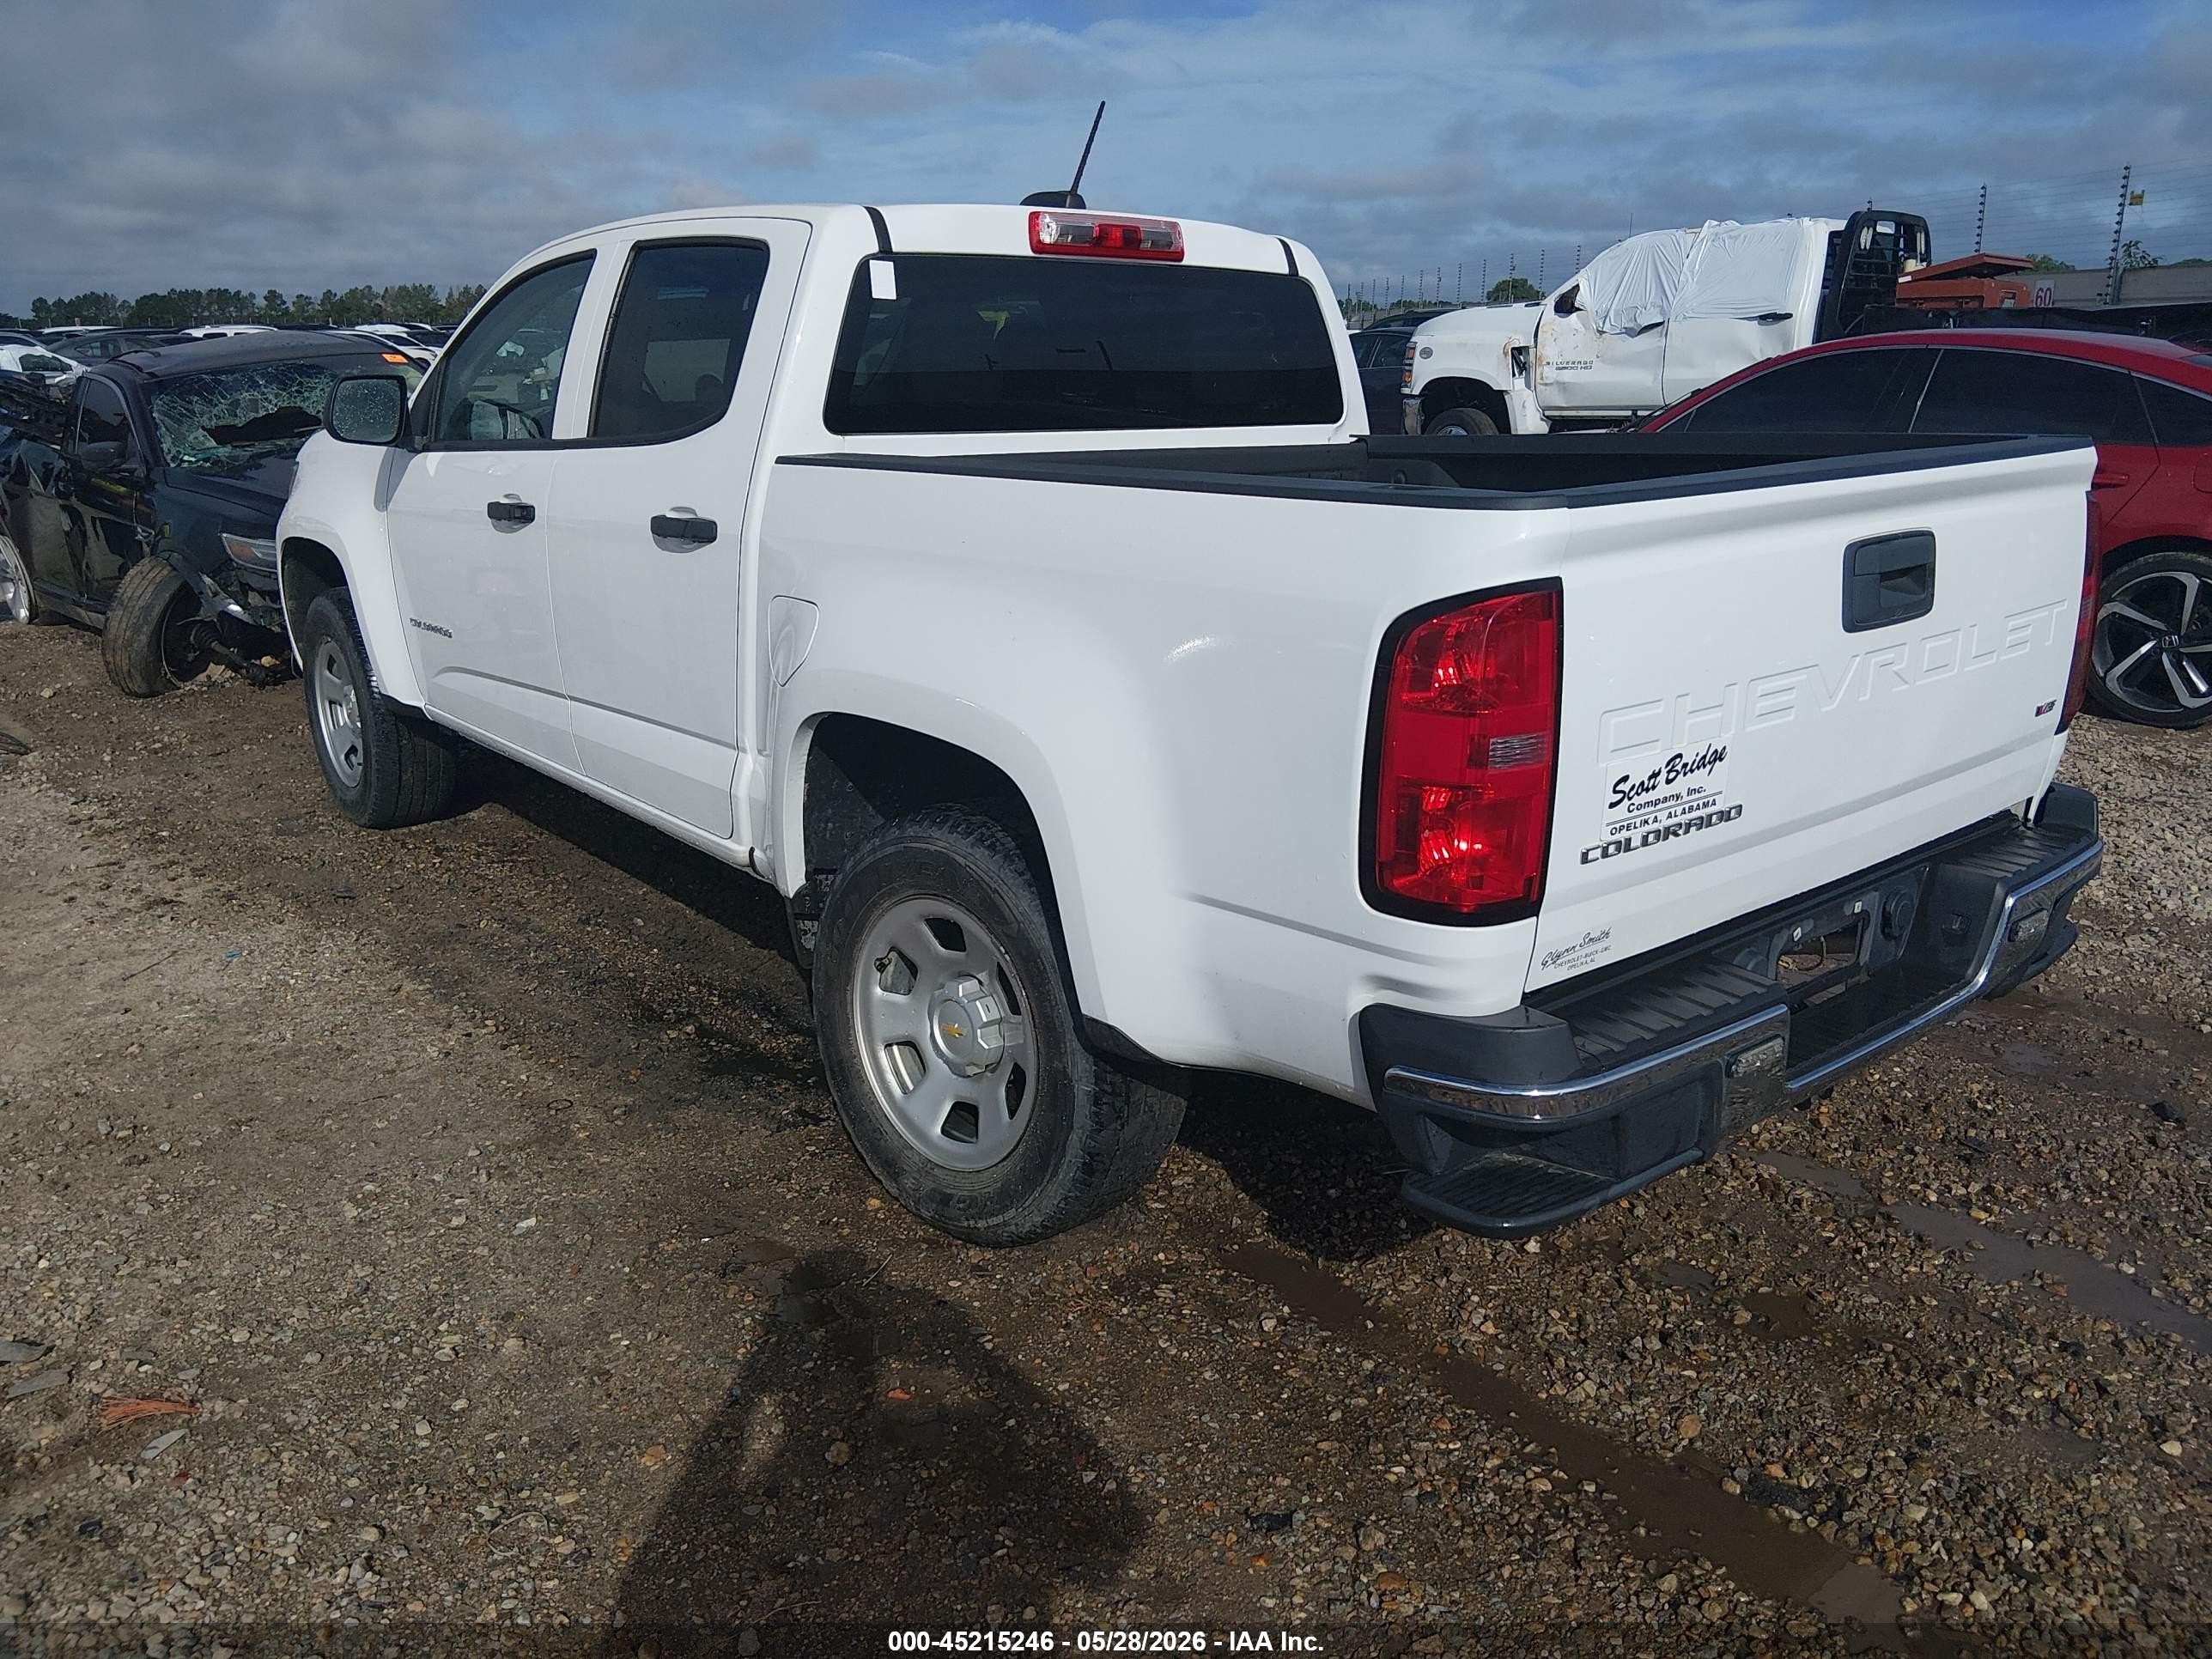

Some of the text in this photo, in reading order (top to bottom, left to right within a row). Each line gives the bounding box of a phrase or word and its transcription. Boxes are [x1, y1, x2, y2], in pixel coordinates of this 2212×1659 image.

[1597, 599, 2069, 763] CHEVROLET
[1607, 743, 1728, 810] Scott Bridge
[1627, 785, 1707, 814] Company, Inc.
[1580, 804, 1743, 866] COLORADO
[1609, 798, 1717, 836] OPELIKA, ALABAMA
[1579, 927, 1612, 948] Smith
